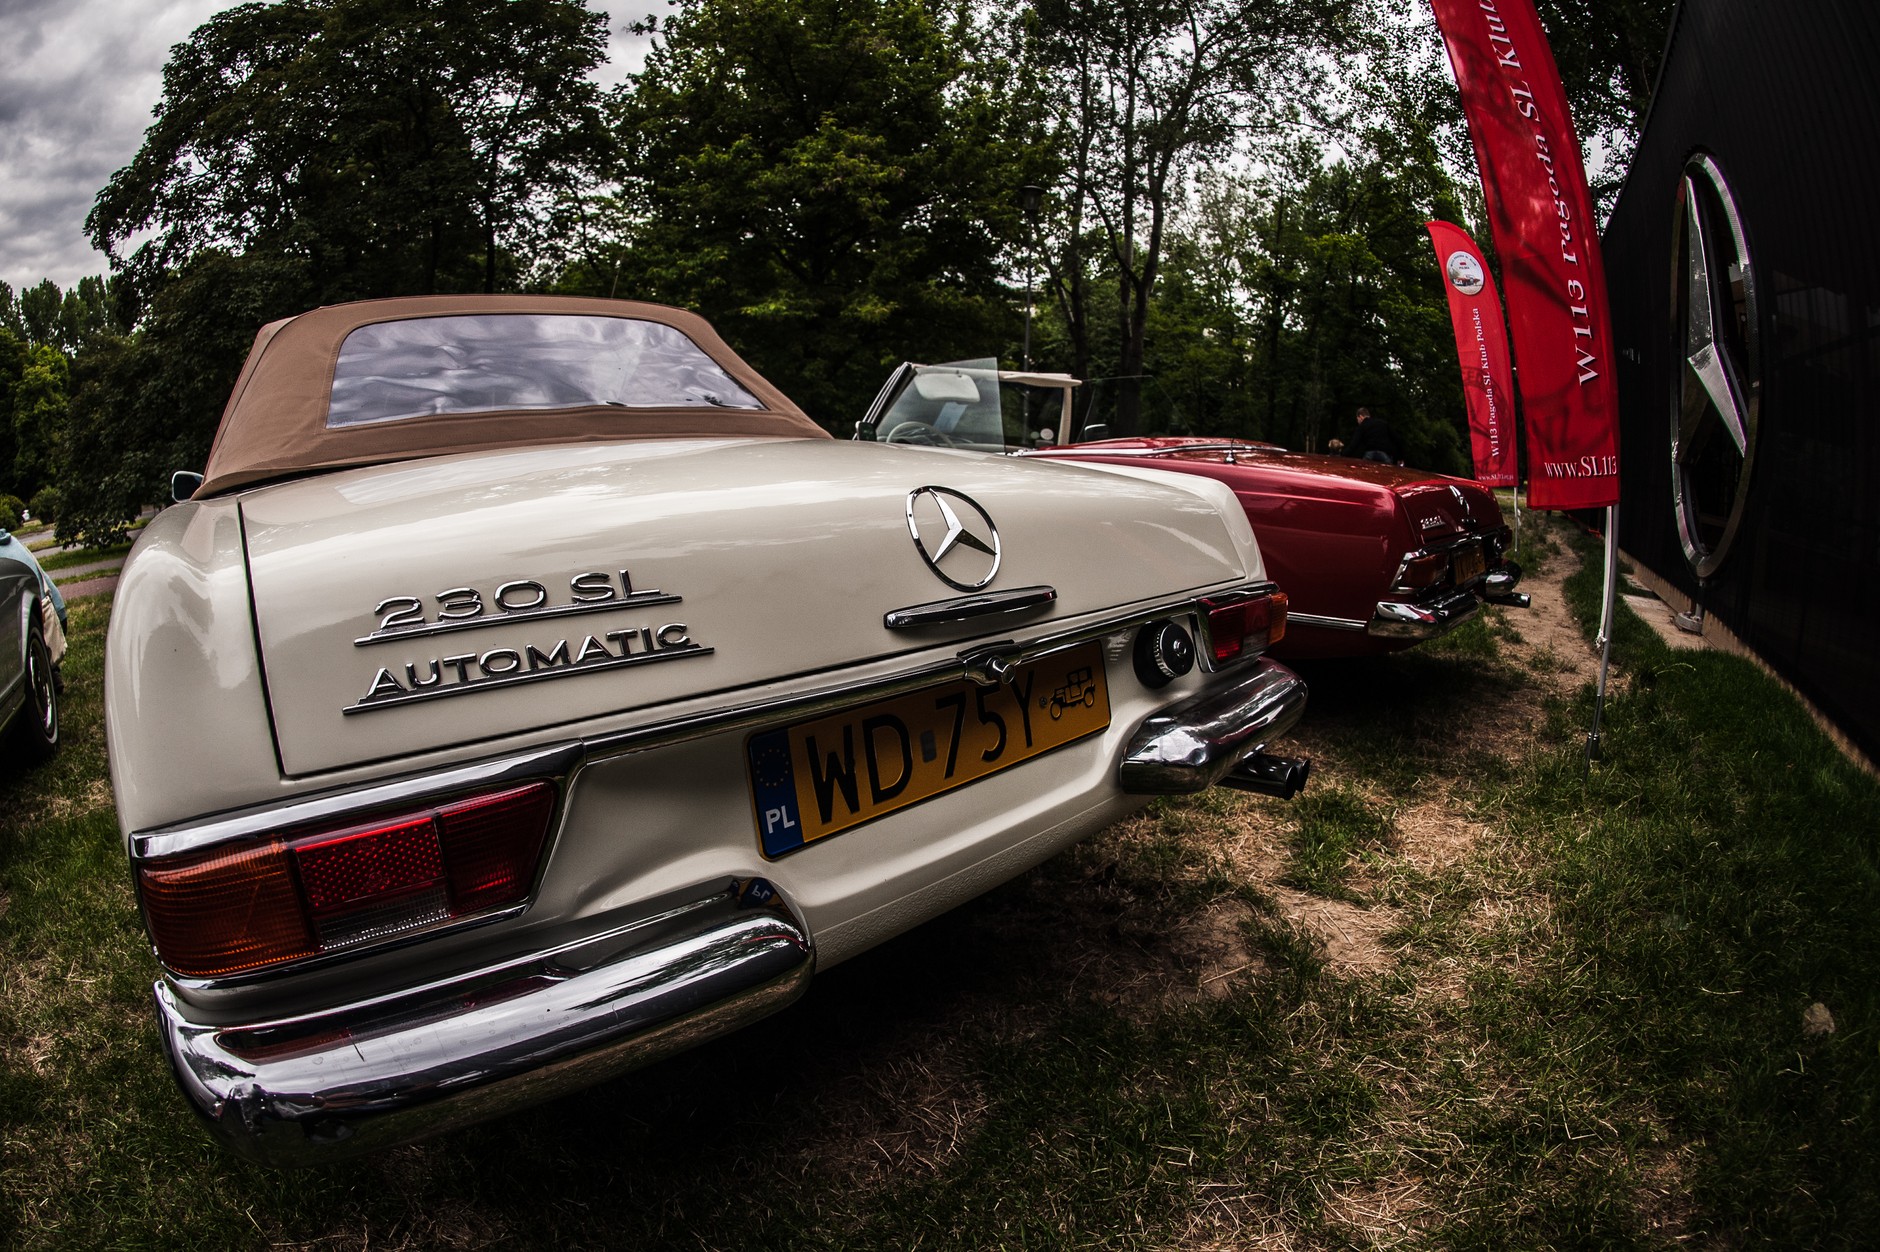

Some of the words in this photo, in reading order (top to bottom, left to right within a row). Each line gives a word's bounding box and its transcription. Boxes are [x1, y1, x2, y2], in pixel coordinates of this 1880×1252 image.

[1509, 80, 1541, 123] SL
[1534, 131, 1580, 266] Pagoda
[1472, 308, 1486, 342] Polska
[1567, 279, 1599, 386] W113
[1479, 344, 1490, 369] Klub
[1482, 372, 1492, 386] SL
[1486, 388, 1498, 425] Pagoda
[1489, 427, 1500, 457] W113
[1544, 455, 1617, 478] www.SL113
[374, 579, 548, 630] 230
[569, 569, 662, 603] SL
[366, 623, 691, 697] AUTOMATIC
[805, 713, 913, 825] WD
[936, 670, 1035, 780] 75Y
[765, 805, 796, 834] PL
